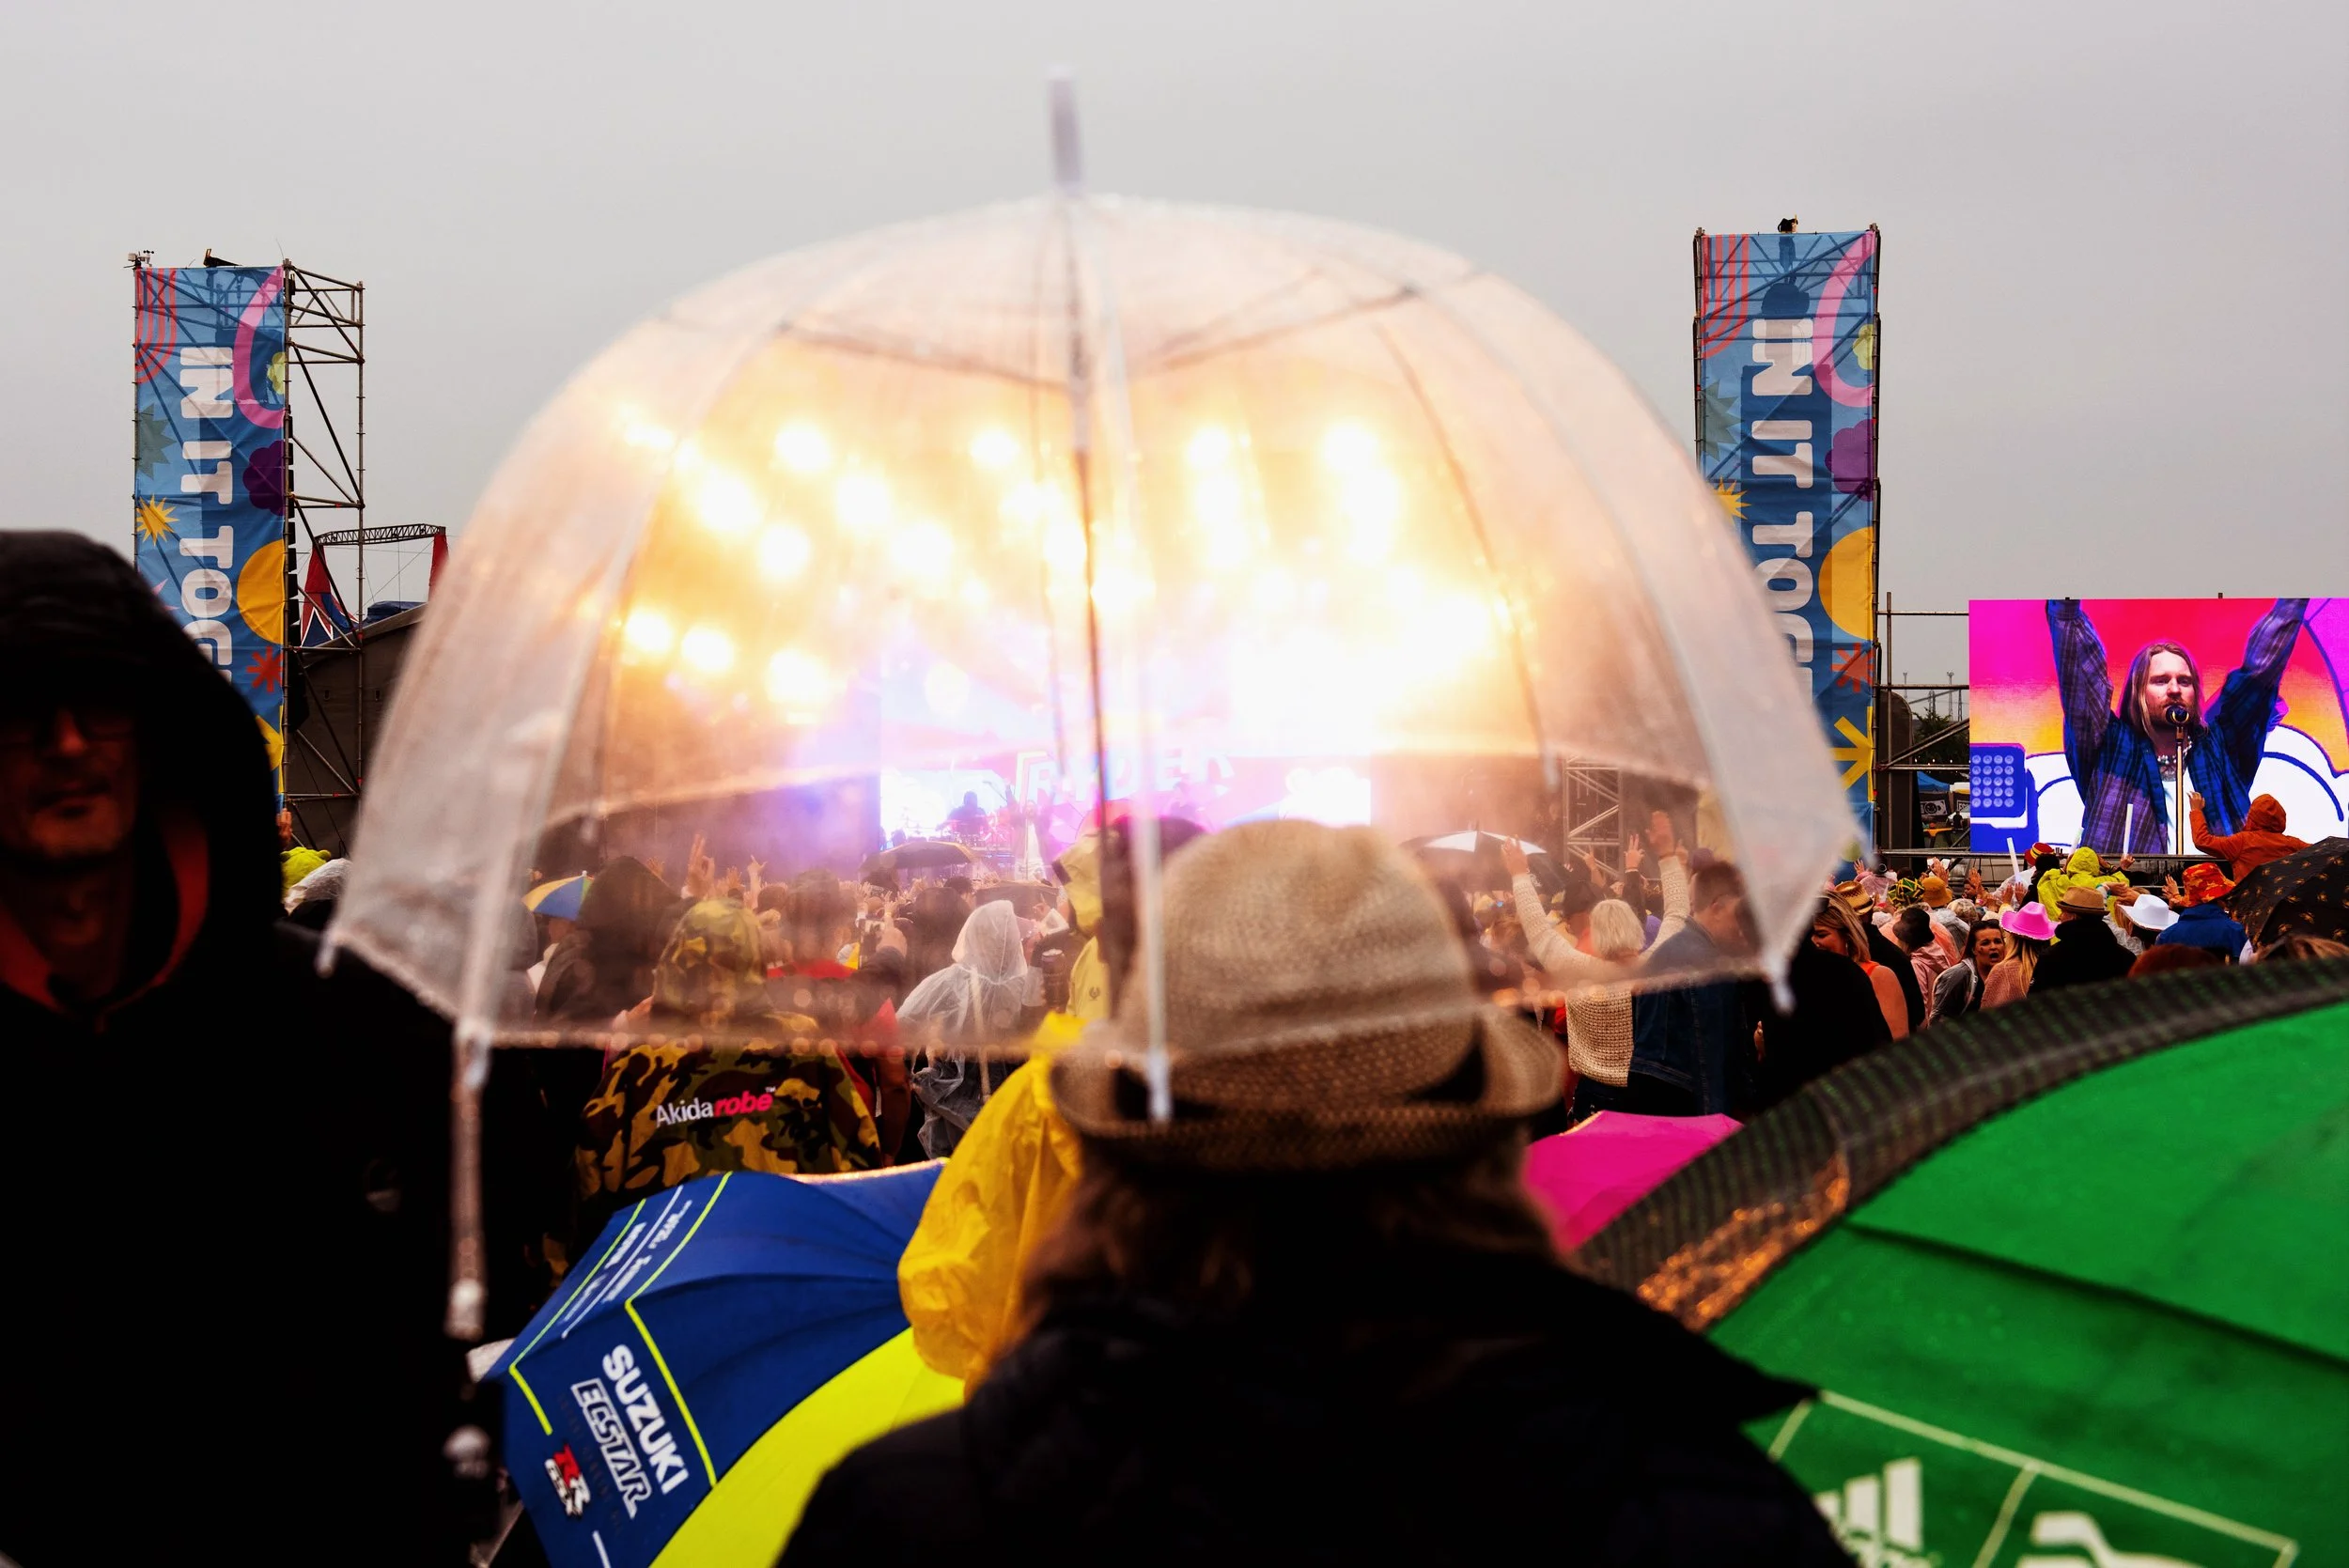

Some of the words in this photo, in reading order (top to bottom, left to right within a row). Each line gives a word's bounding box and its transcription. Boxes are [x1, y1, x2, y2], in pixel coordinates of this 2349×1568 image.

[179, 346, 233, 419] IN
[1751, 318, 1814, 396] IN
[179, 440, 233, 505] IT
[1751, 419, 1814, 489] IT
[179, 524, 233, 684] TOG
[570, 1377, 652, 1520] ECSTAR
[602, 1343, 689, 1495] SUZUKI
